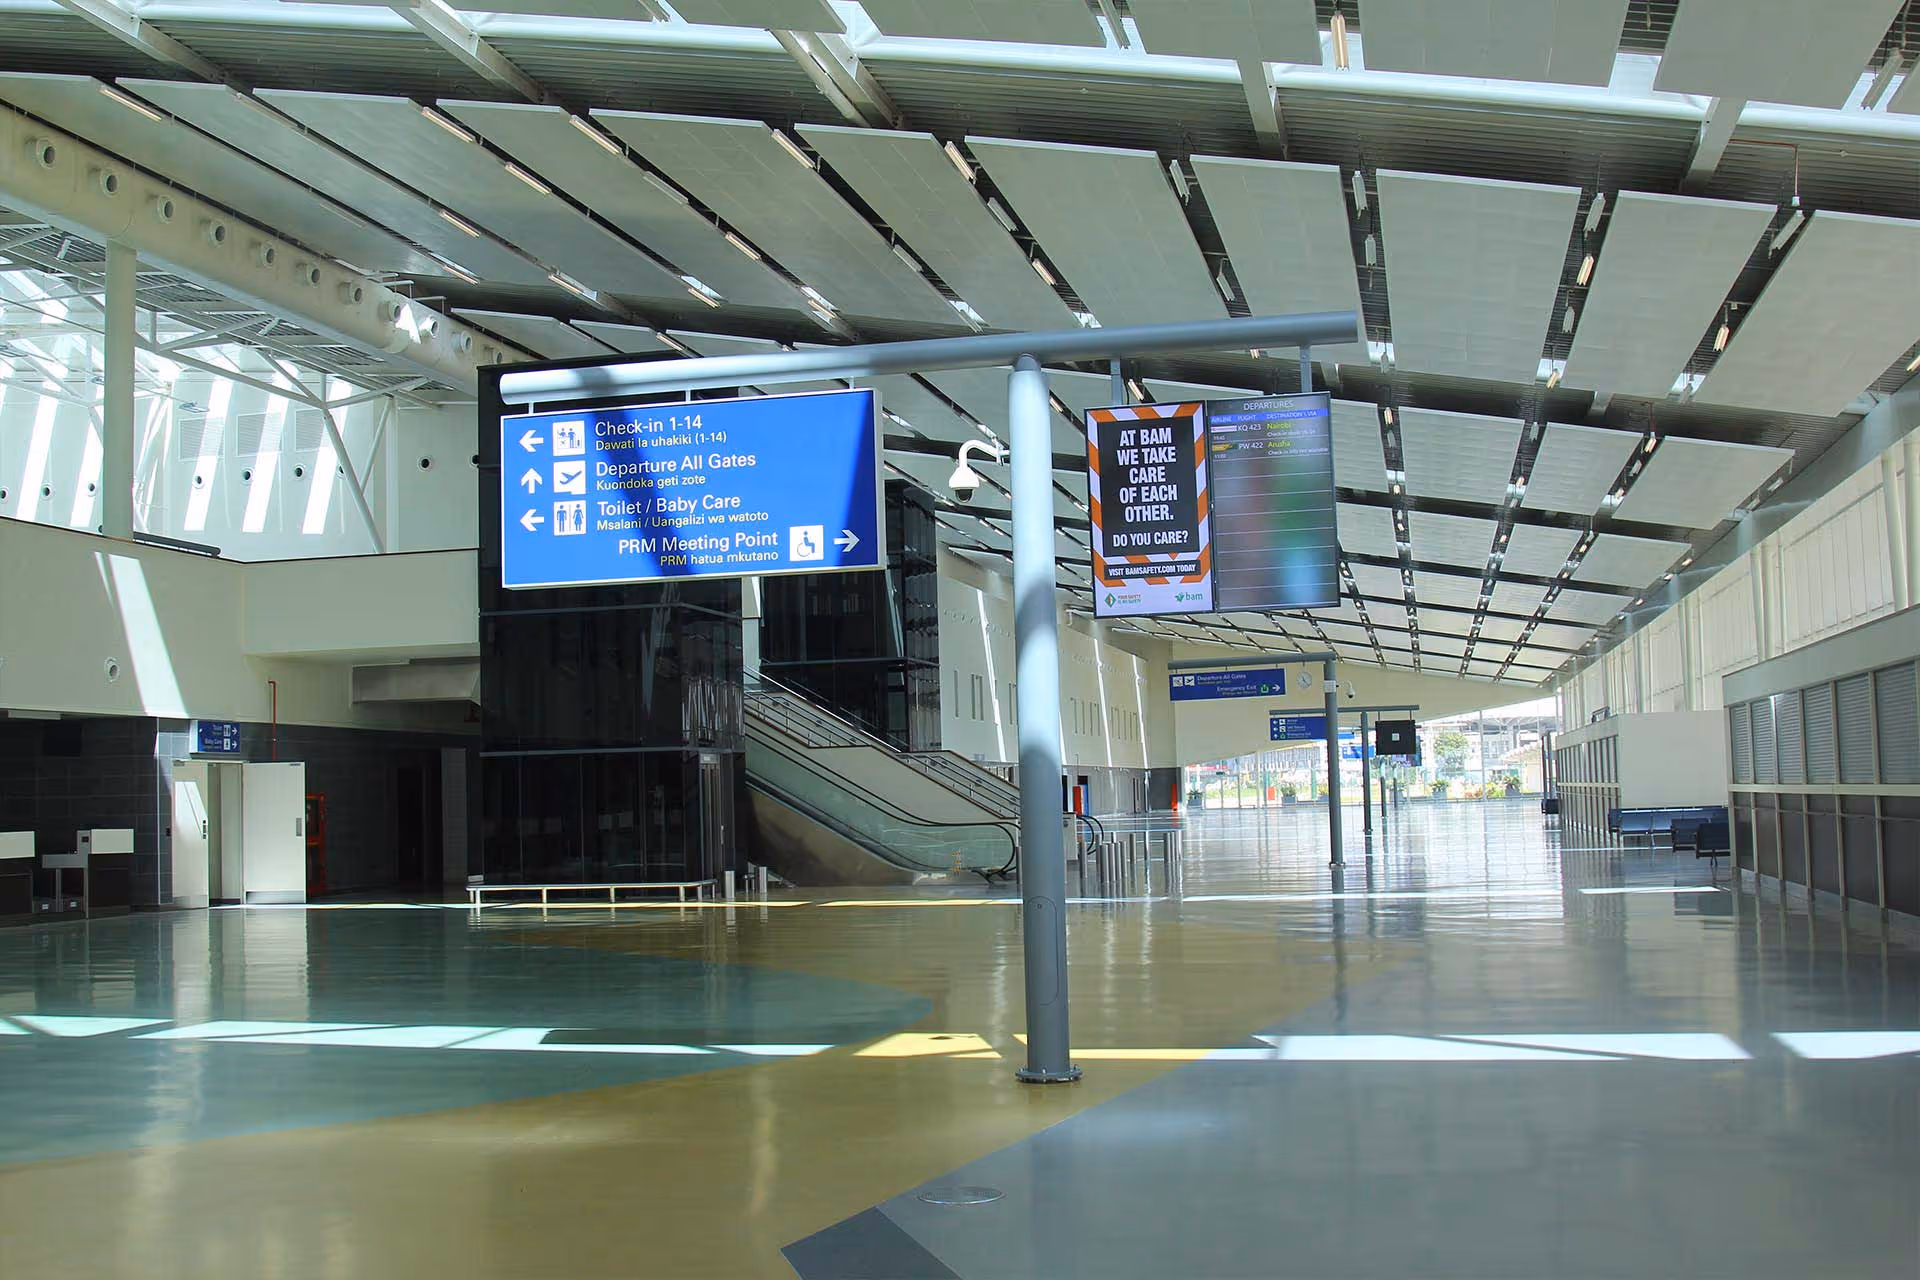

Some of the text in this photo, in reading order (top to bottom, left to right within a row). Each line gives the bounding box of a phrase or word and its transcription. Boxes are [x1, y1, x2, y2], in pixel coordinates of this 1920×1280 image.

[1243, 400, 1294, 411] DEPARTURES
[595, 414, 702, 436] Check-in 1-14
[1249, 423, 1261, 431] 423
[595, 431, 727, 451] Dawati la uhakiki (1-14)
[1119, 427, 1172, 446] AT BAM
[596, 453, 757, 478] Departure All Gates
[1116, 446, 1177, 466] WE TAKE
[596, 475, 706, 491] Kuondoka geti zote
[1129, 466, 1166, 484] CARE
[1119, 484, 1178, 504] OF EACH
[597, 494, 741, 516] Toilet / Baby Care
[1125, 504, 1174, 523] OTHER.
[597, 511, 769, 531] Msalani / Uangalizi wa watoto
[618, 531, 779, 554] PRM Meeting Point
[1113, 530, 1189, 547] DO YOU CARE?
[660, 549, 779, 566] PRM hatua mkutano
[1108, 564, 1197, 577] VISIT BAMSAFETY.COM TODAY
[1186, 592, 1203, 601] bam
